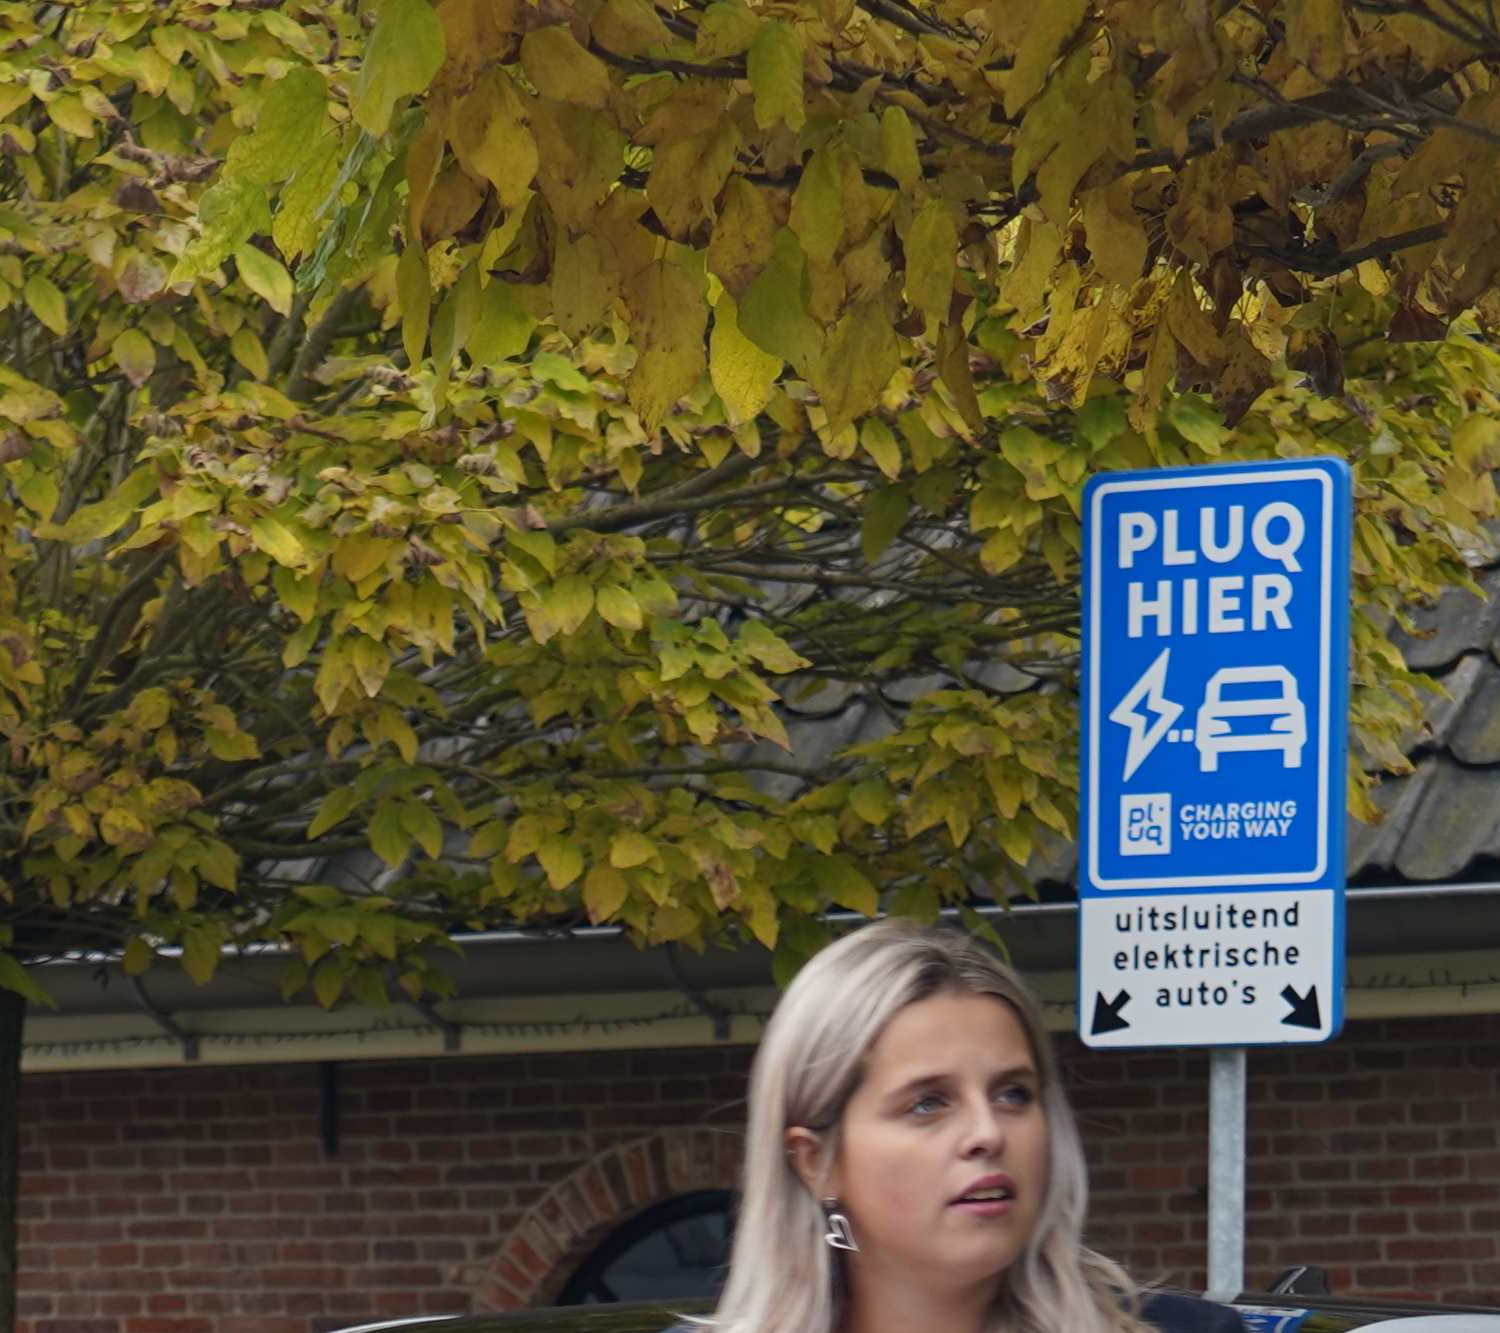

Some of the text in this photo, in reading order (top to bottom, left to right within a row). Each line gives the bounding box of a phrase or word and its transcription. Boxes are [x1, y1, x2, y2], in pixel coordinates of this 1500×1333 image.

[1118, 501, 1306, 573] PLUQ
[1127, 573, 1294, 638] HIER
[1179, 800, 1297, 822] CHARGING
[1179, 819, 1293, 841] YOUR WAY
[1114, 901, 1300, 934] uitsluitend
[1112, 941, 1300, 972] elektrische
[1155, 979, 1257, 1008] auto's
